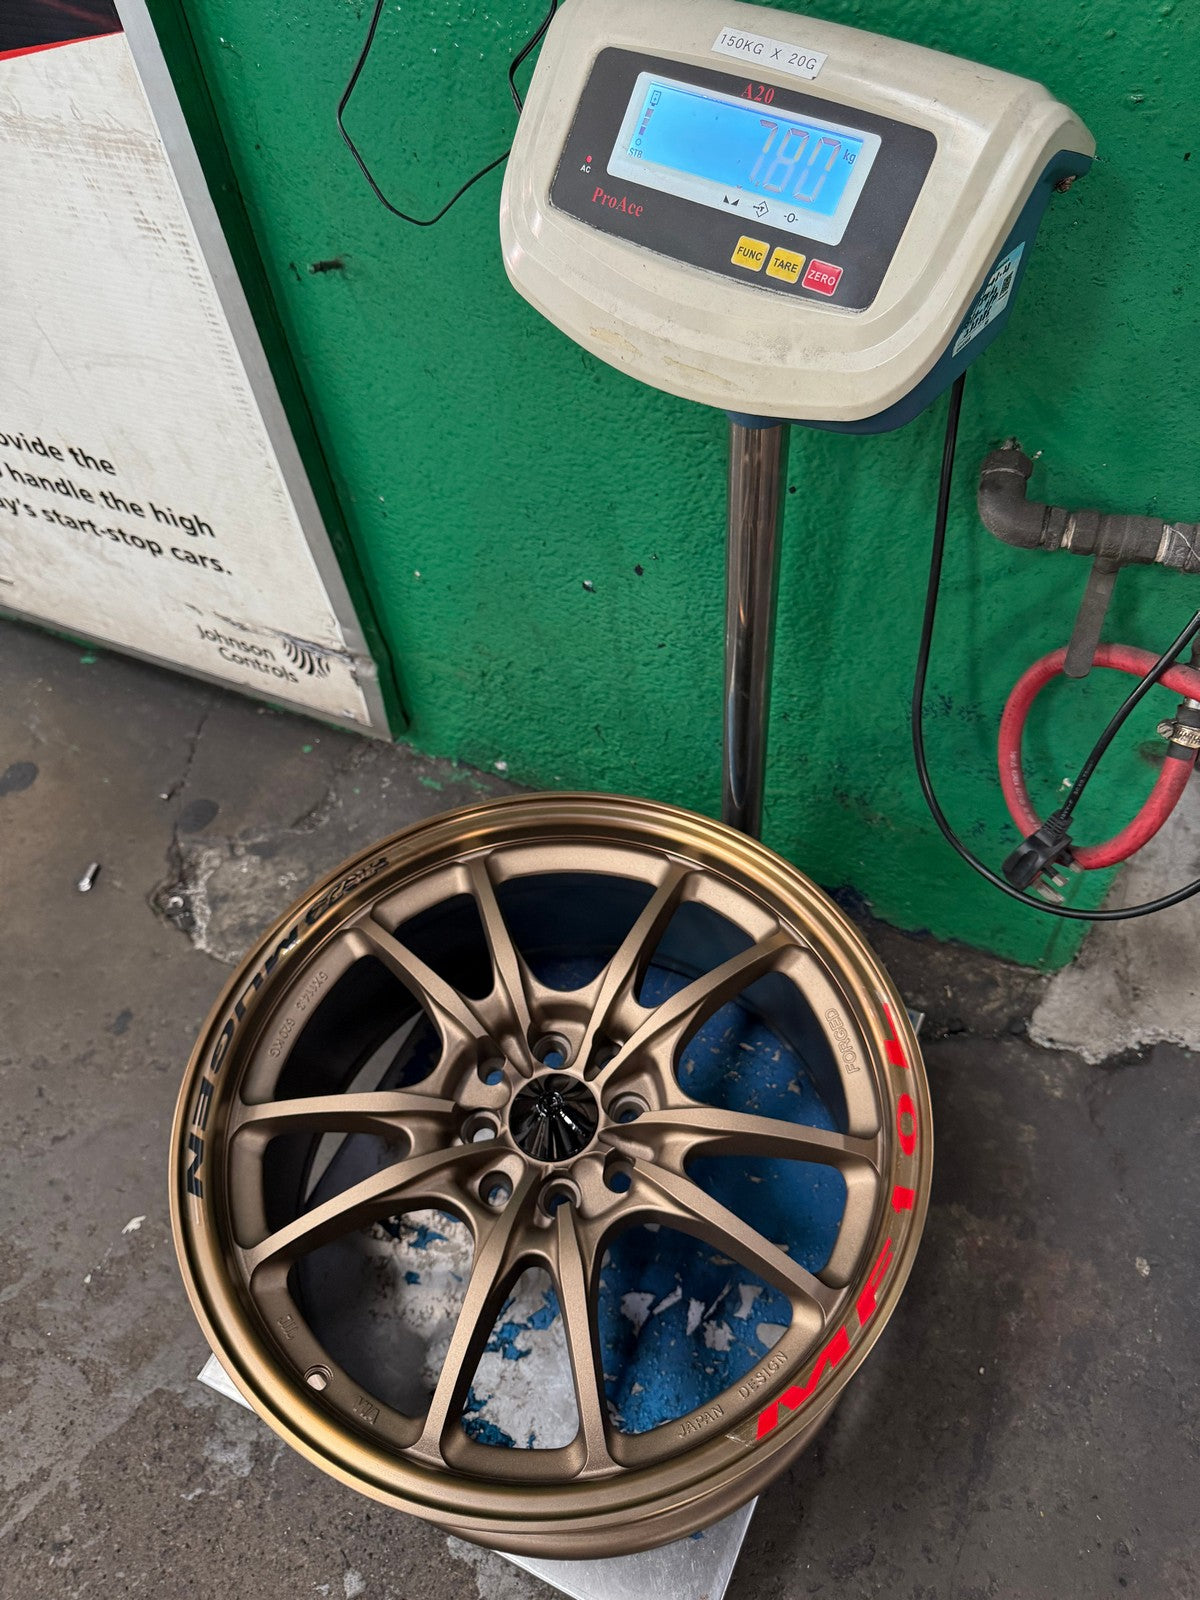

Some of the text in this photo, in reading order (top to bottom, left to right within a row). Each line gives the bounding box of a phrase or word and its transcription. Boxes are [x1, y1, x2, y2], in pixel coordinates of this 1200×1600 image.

[720, 34, 818, 70] 150KG X 20G
[741, 83, 775, 104] A20
[580, 164, 591, 174] AC
[843, 149, 857, 165] kg
[592, 186, 644, 217] ProAce
[736, 246, 763, 262] FUNC
[774, 257, 799, 273] TARE
[808, 269, 837, 286] ZERO
[68, 447, 116, 477] the
[4, 462, 216, 538] handle the high
[41, 509, 163, 558] start-stop
[171, 546, 232, 576] cars.
[219, 646, 300, 683] Controls
[824, 1007, 861, 1075] FORGED
[678, 1350, 789, 1438] JAPAN DESIGN
